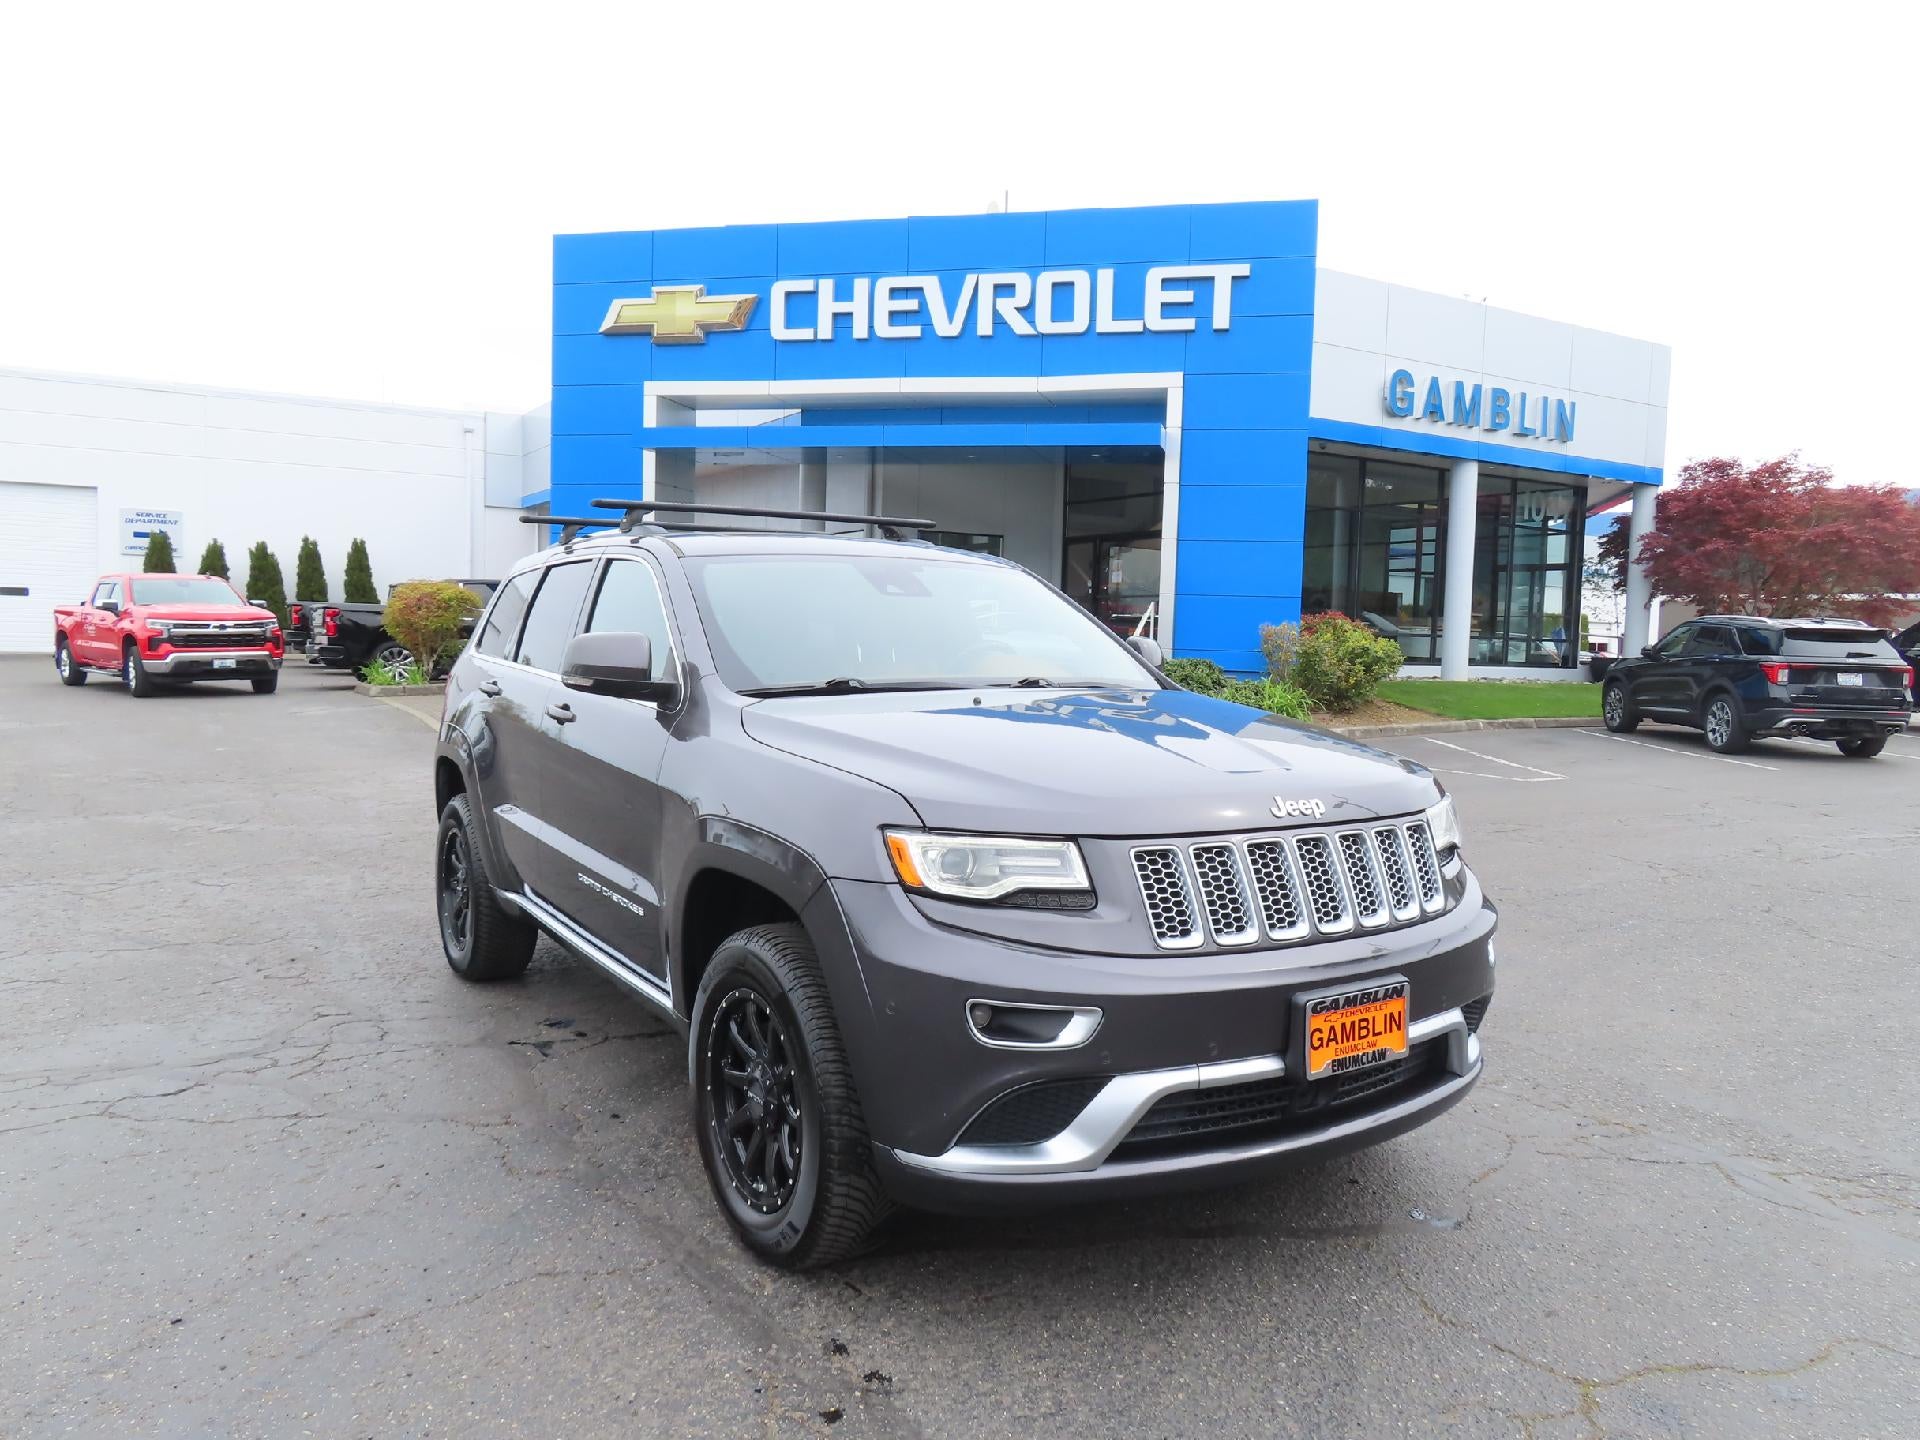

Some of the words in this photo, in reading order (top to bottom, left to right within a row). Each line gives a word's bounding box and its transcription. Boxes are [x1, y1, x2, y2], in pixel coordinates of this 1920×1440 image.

[769, 263, 1251, 341] CHEVROLET
[1385, 368, 1576, 443] GAMBLIN
[1270, 795, 1326, 820] Jeep
[1311, 984, 1405, 1014] GAMBLIN
[1345, 1003, 1389, 1018] CHEVROLET
[1310, 1010, 1402, 1050] GAMBLIN
[1331, 1048, 1387, 1073] ENUMCLAW
[1334, 1039, 1378, 1056] ENUMCLAW
